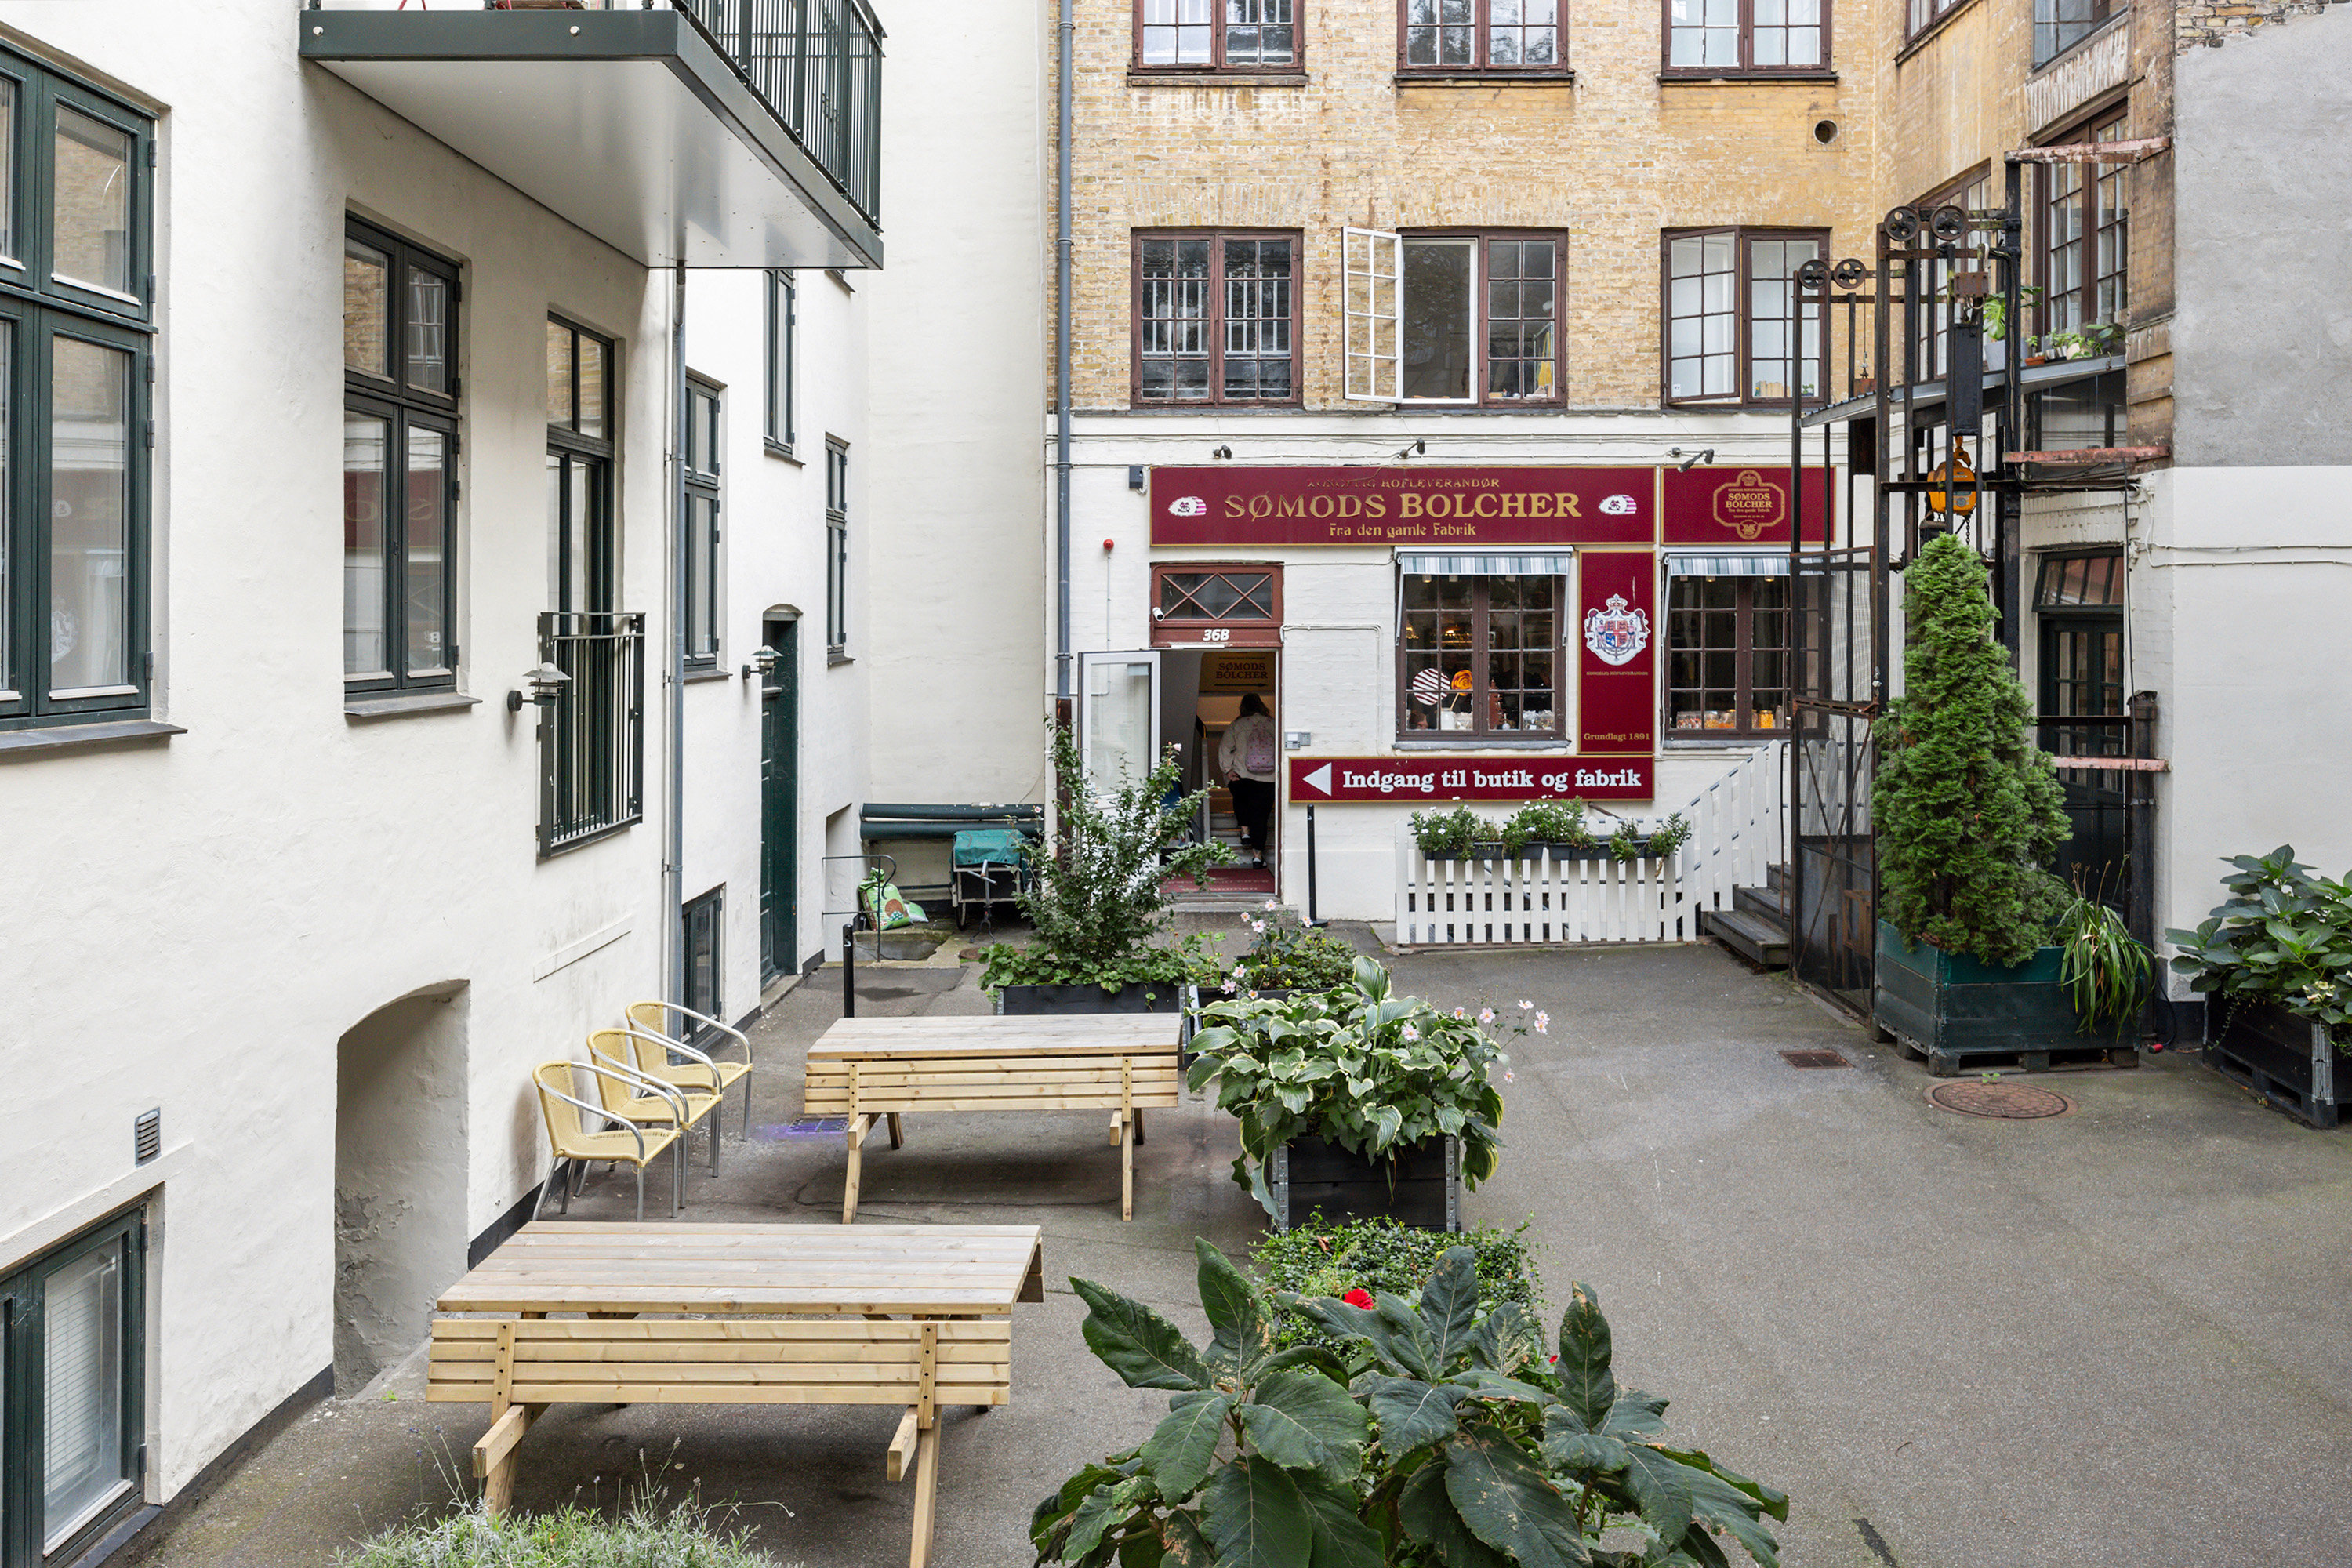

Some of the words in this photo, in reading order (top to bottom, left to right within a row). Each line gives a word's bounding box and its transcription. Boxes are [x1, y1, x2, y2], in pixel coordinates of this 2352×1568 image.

[1381, 478, 1500, 488] HOFLEVERANDØR
[1224, 492, 1386, 521] SØMODS
[1399, 492, 1582, 518] BOLCHER
[1330, 523, 1352, 536] Fra
[1357, 524, 1382, 536] den
[1387, 524, 1427, 539] gamle
[1433, 523, 1476, 536] Fabrik
[1203, 629, 1230, 641] 36B
[1584, 732, 1627, 742] Grundlagt
[1342, 770, 1436, 793] Indgang
[1441, 769, 1466, 787] til
[1473, 769, 1534, 788] butik
[1541, 772, 1569, 792] og
[1574, 768, 1642, 787] fabrik
